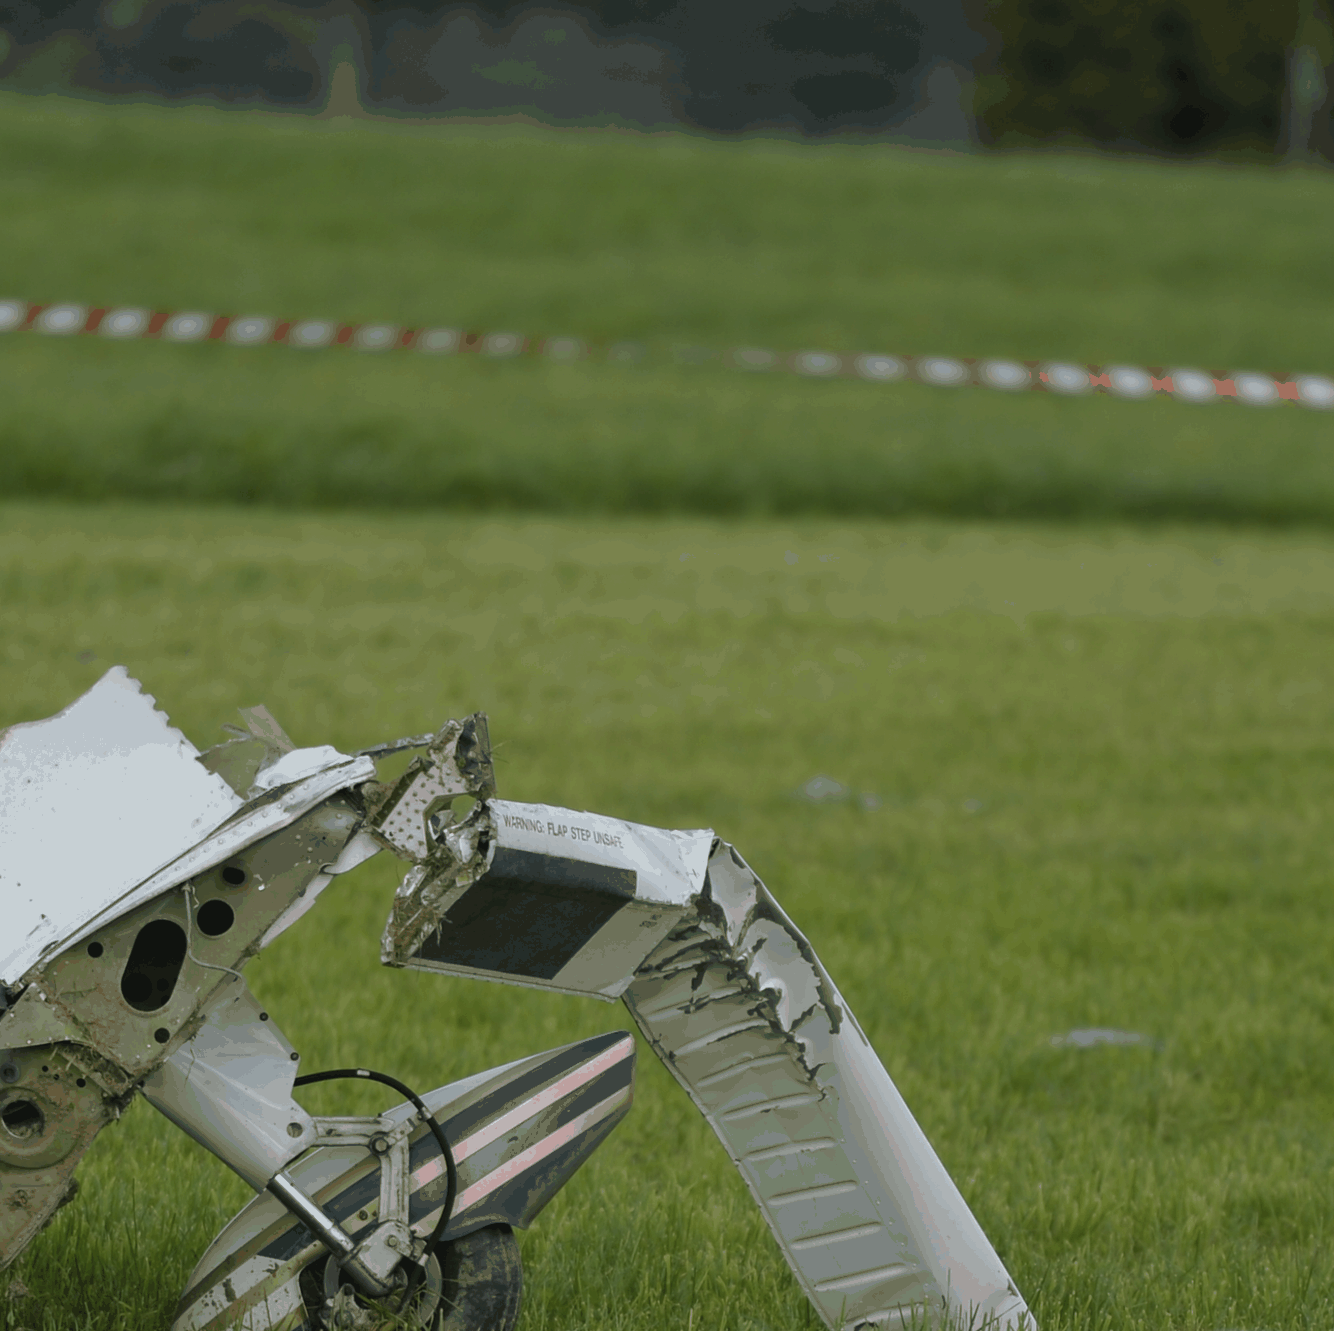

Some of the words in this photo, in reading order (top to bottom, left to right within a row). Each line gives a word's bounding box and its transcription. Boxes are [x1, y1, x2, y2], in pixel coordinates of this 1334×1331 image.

[503, 814, 545, 834] WARNING:
[547, 822, 568, 837] FLAP
[571, 826, 591, 842] STEP
[593, 831, 624, 849] UNSAFE
